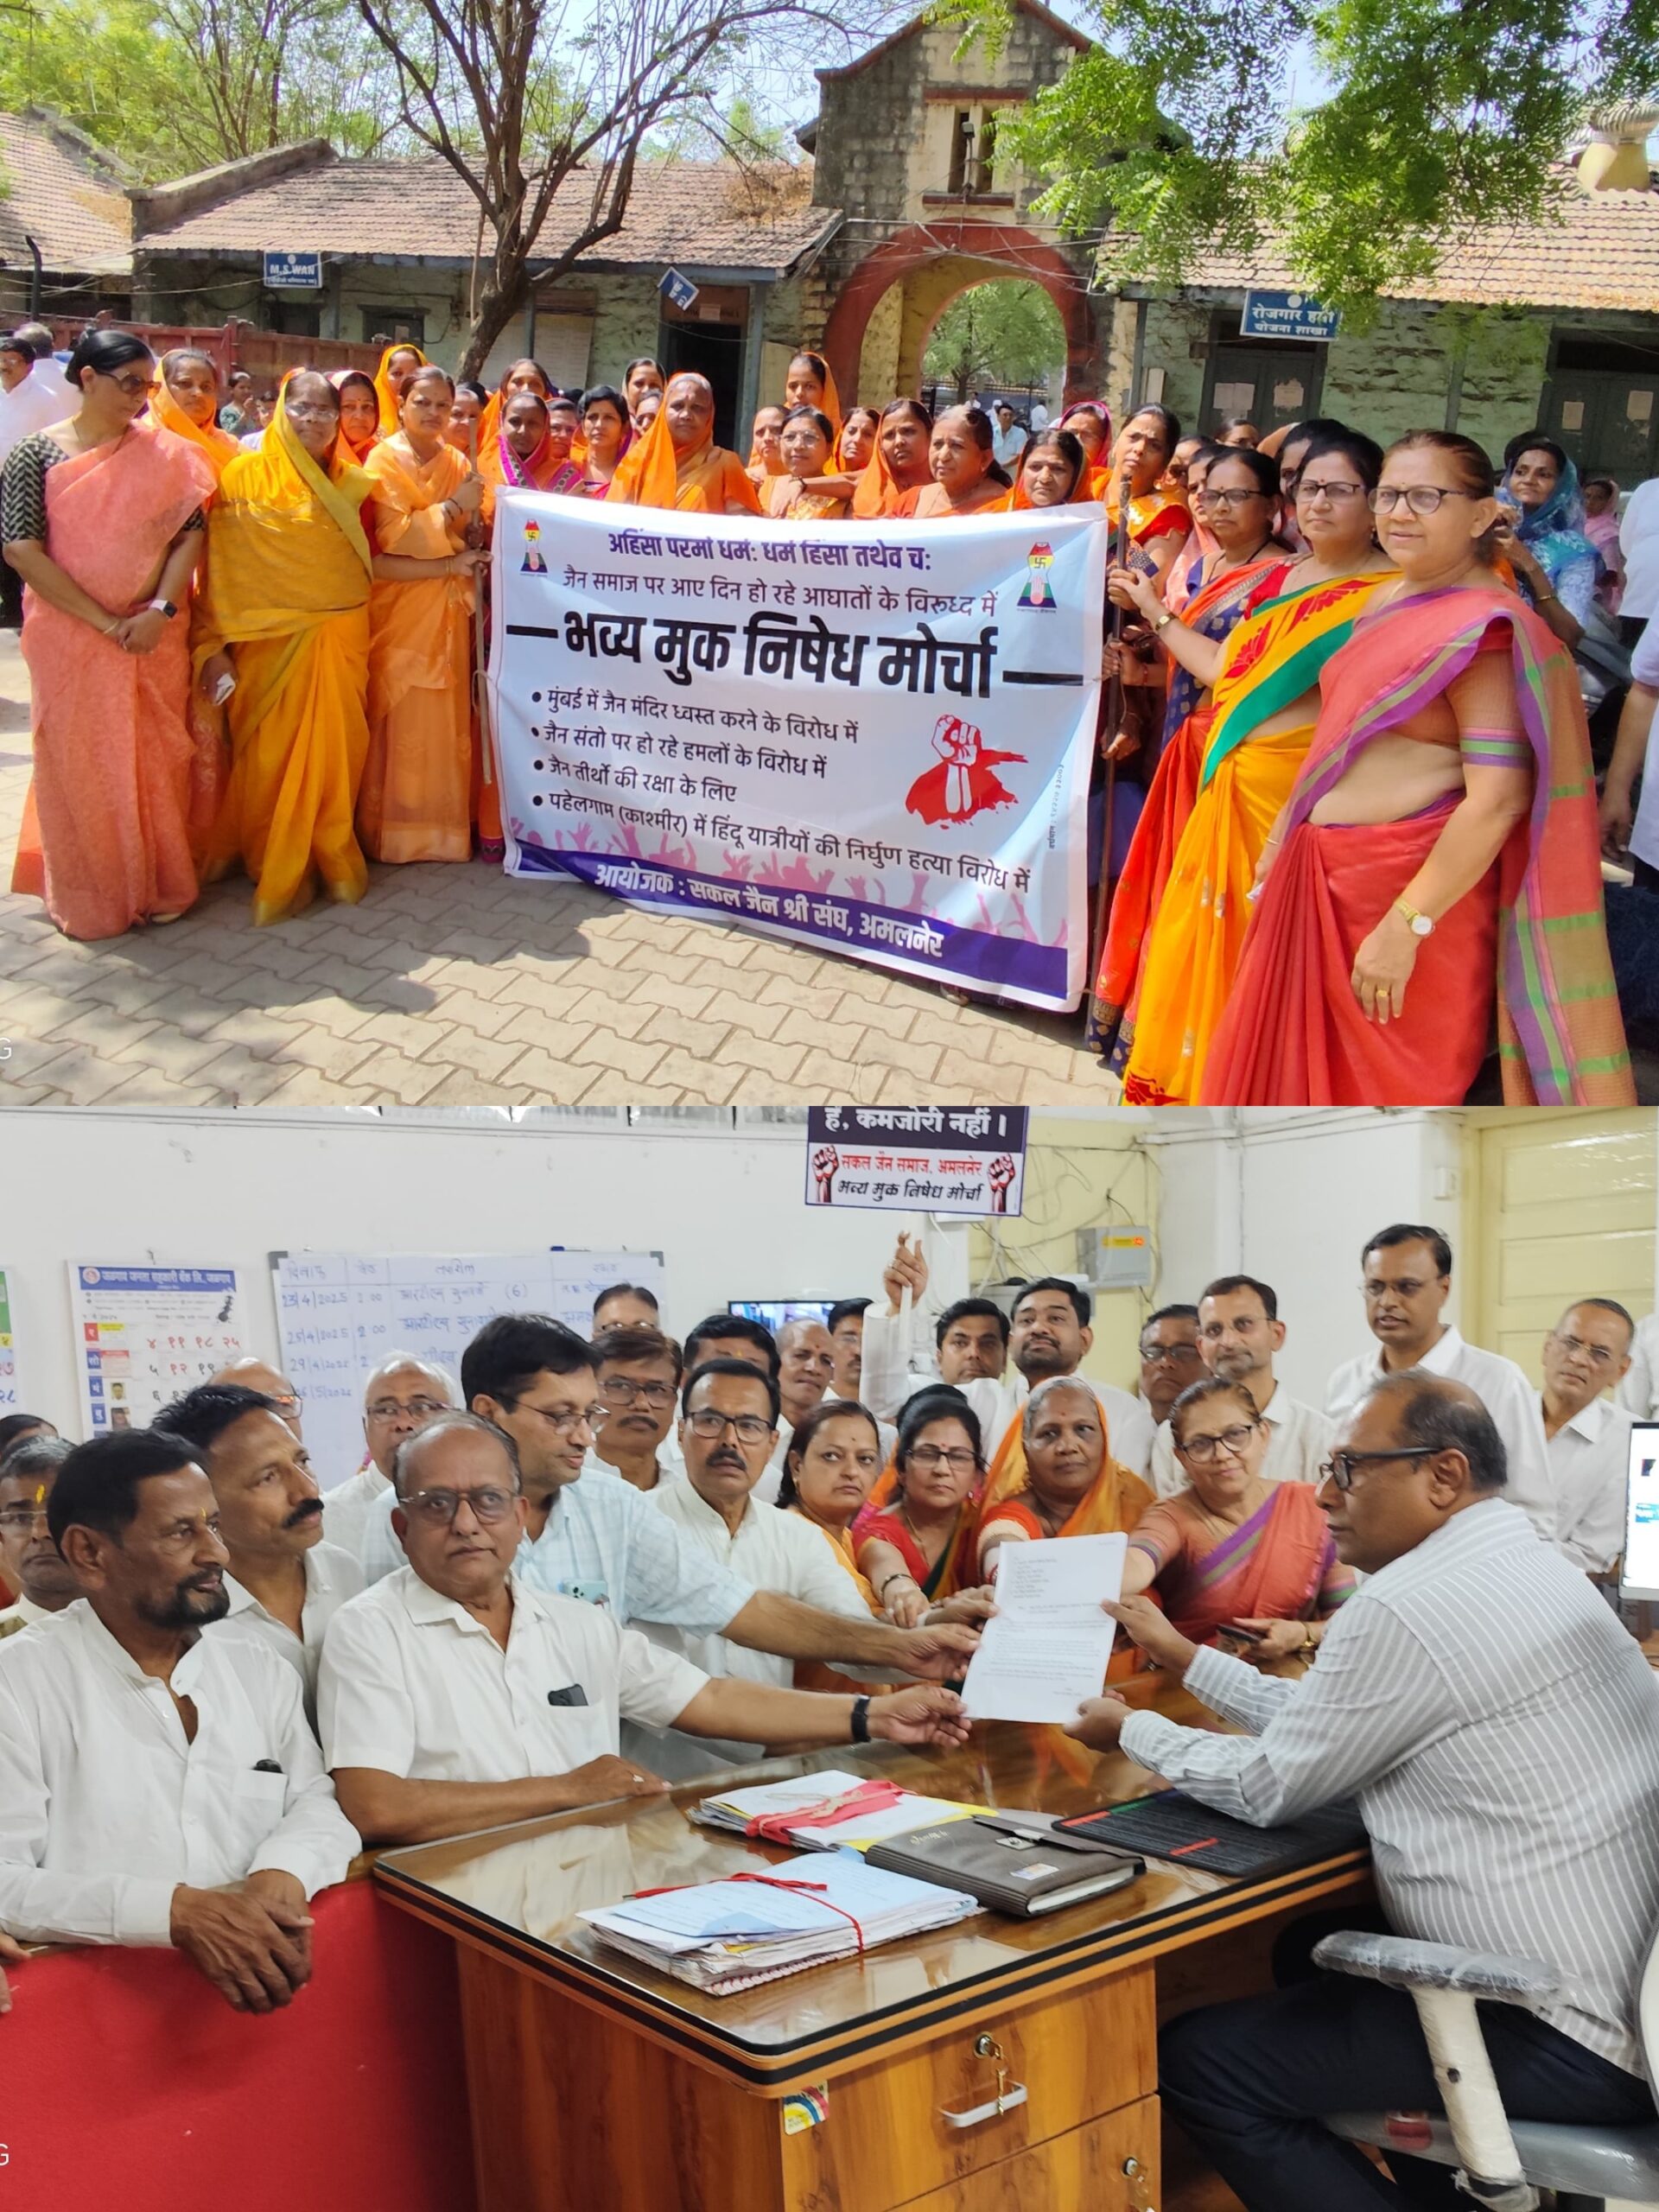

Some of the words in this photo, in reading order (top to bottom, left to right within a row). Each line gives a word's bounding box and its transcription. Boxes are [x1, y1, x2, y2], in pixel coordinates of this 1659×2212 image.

[1252, 303, 1302, 321] रोजगार
[1255, 321, 1291, 334] योजना
[1295, 325, 1327, 336] शाखा
[608, 528, 663, 556] अहिंसा
[563, 564, 588, 588] जैन
[592, 572, 639, 594] समाज
[643, 575, 665, 595] पर
[671, 578, 705, 597] आए
[709, 575, 742, 601] दिन
[747, 577, 768, 603] हो
[772, 580, 797, 606] रहे
[803, 584, 872, 610] आघातों
[878, 586, 899, 612] के
[981, 589, 999, 617] में
[563, 611, 647, 663] भव्य
[653, 619, 737, 686] मुक
[743, 611, 870, 686] निषेध
[877, 622, 999, 698] मोर्चा
[547, 686, 583, 714] मुंबई
[587, 689, 600, 710] में
[602, 690, 626, 714] जैन
[631, 696, 668, 720] मंदिर
[672, 704, 715, 726] ध्वस्त
[719, 709, 758, 731] करने
[762, 710, 781, 734] के
[785, 713, 838, 741] विरोध
[843, 720, 859, 744] में
[543, 720, 569, 745] जैन
[611, 733, 632, 752] पर
[636, 731, 653, 754] हो
[658, 734, 679, 758] रहे
[683, 741, 730, 765] हमलों
[734, 744, 753, 766] के
[757, 747, 808, 776] विरोध
[812, 753, 828, 779] में
[548, 753, 571, 777] जैन
[614, 766, 638, 790] की
[643, 773, 675, 794] रक्षा
[679, 773, 697, 797] के
[701, 776, 737, 802] लिए
[549, 789, 614, 818] पहेलगाम
[693, 812, 707, 836] में
[711, 813, 745, 849] हिंदू
[747, 826, 810, 854] यात्रीयों
[814, 834, 841, 858] की
[907, 848, 953, 875] हत्या
[957, 855, 1009, 889] विरोध
[1013, 868, 1032, 893] में
[594, 861, 674, 893] आयोजक
[687, 877, 742, 908] सकल
[745, 885, 779, 917] जैन
[783, 893, 809, 923] श्री
[814, 898, 854, 937] संघ,
[859, 912, 944, 957] अमलनेर
[855, 1106, 944, 1133] कमजोरी
[949, 1107, 992, 1139] नहीं
[841, 1154, 872, 1171] सकल
[875, 1151, 893, 1172] जैन
[938, 1154, 982, 1176] अमलनेर
[837, 1179, 868, 1195] भव्य
[872, 1181, 900, 1202] मुक
[903, 1179, 943, 1199] निषेध
[946, 1182, 984, 1201] मोर्चा
